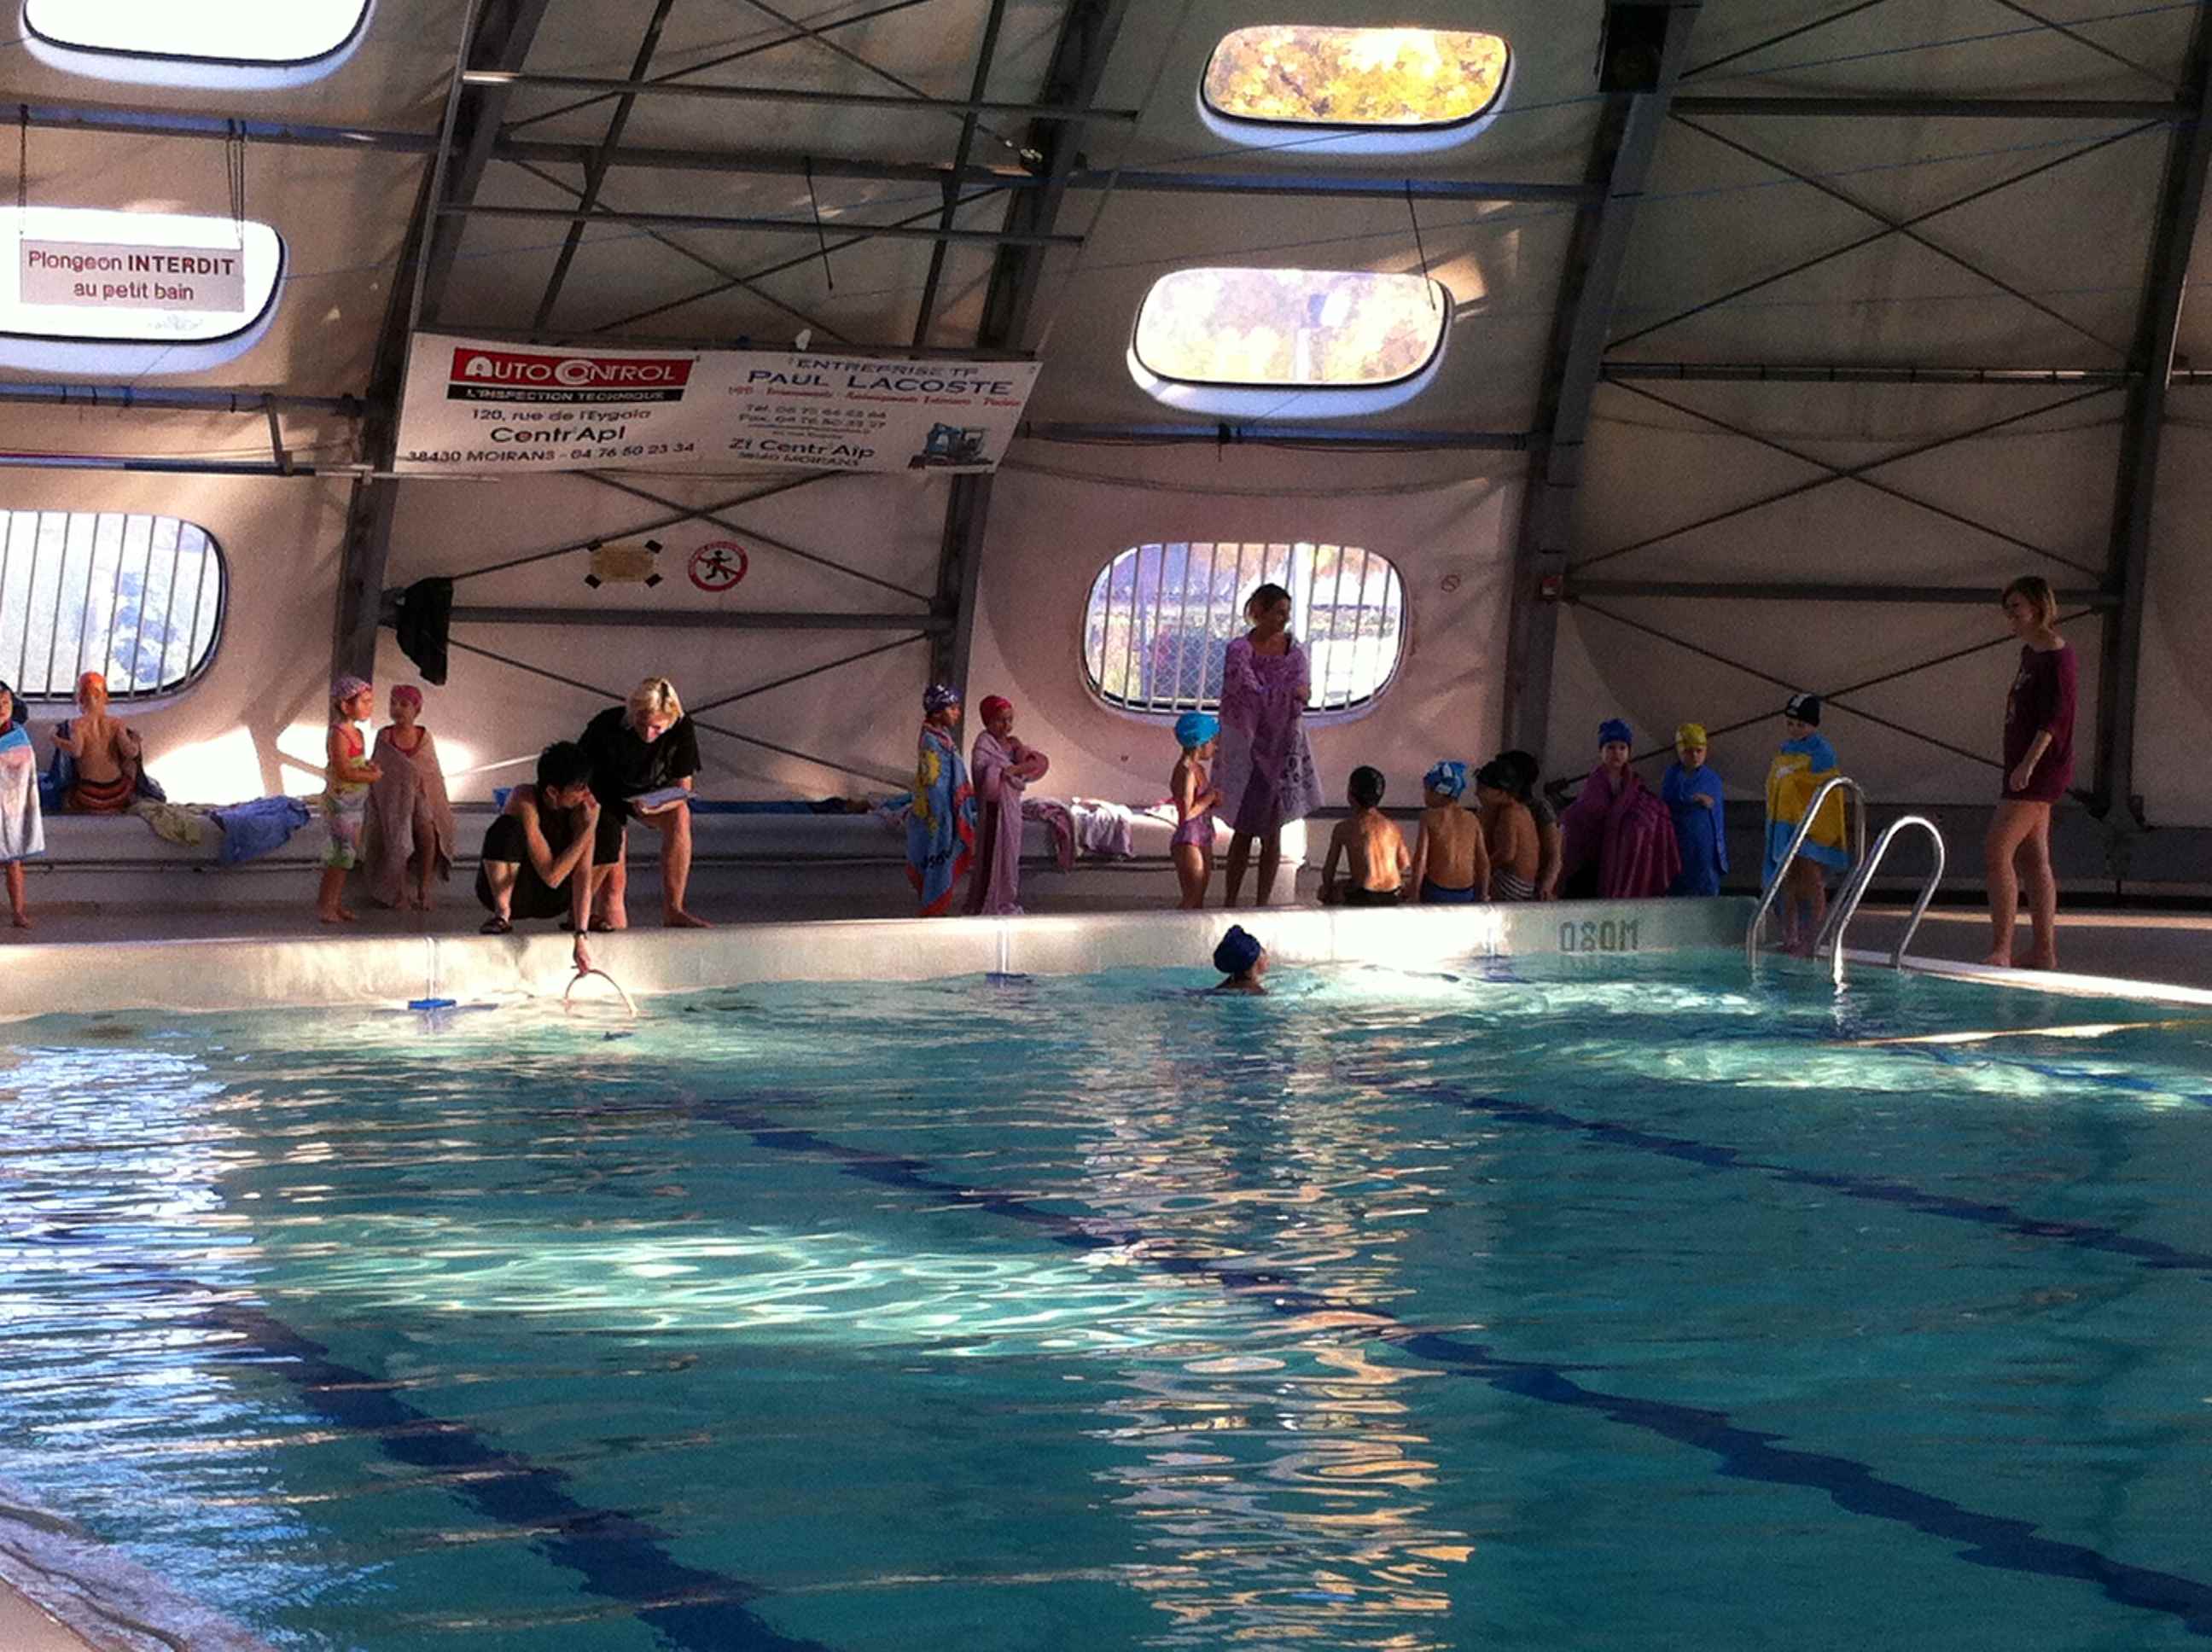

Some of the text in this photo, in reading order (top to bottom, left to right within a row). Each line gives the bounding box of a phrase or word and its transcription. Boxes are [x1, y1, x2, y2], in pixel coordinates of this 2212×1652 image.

[28, 250, 235, 276] Plongeon INTERDIT
[73, 281, 195, 301] au petit bain
[796, 358, 937, 376] ENTREPRISE
[747, 370, 830, 387] PAUL
[847, 375, 1014, 396] LACOSTE
[512, 412, 543, 421] rue
[549, 410, 573, 421] de
[466, 450, 555, 462] MOIRANS
